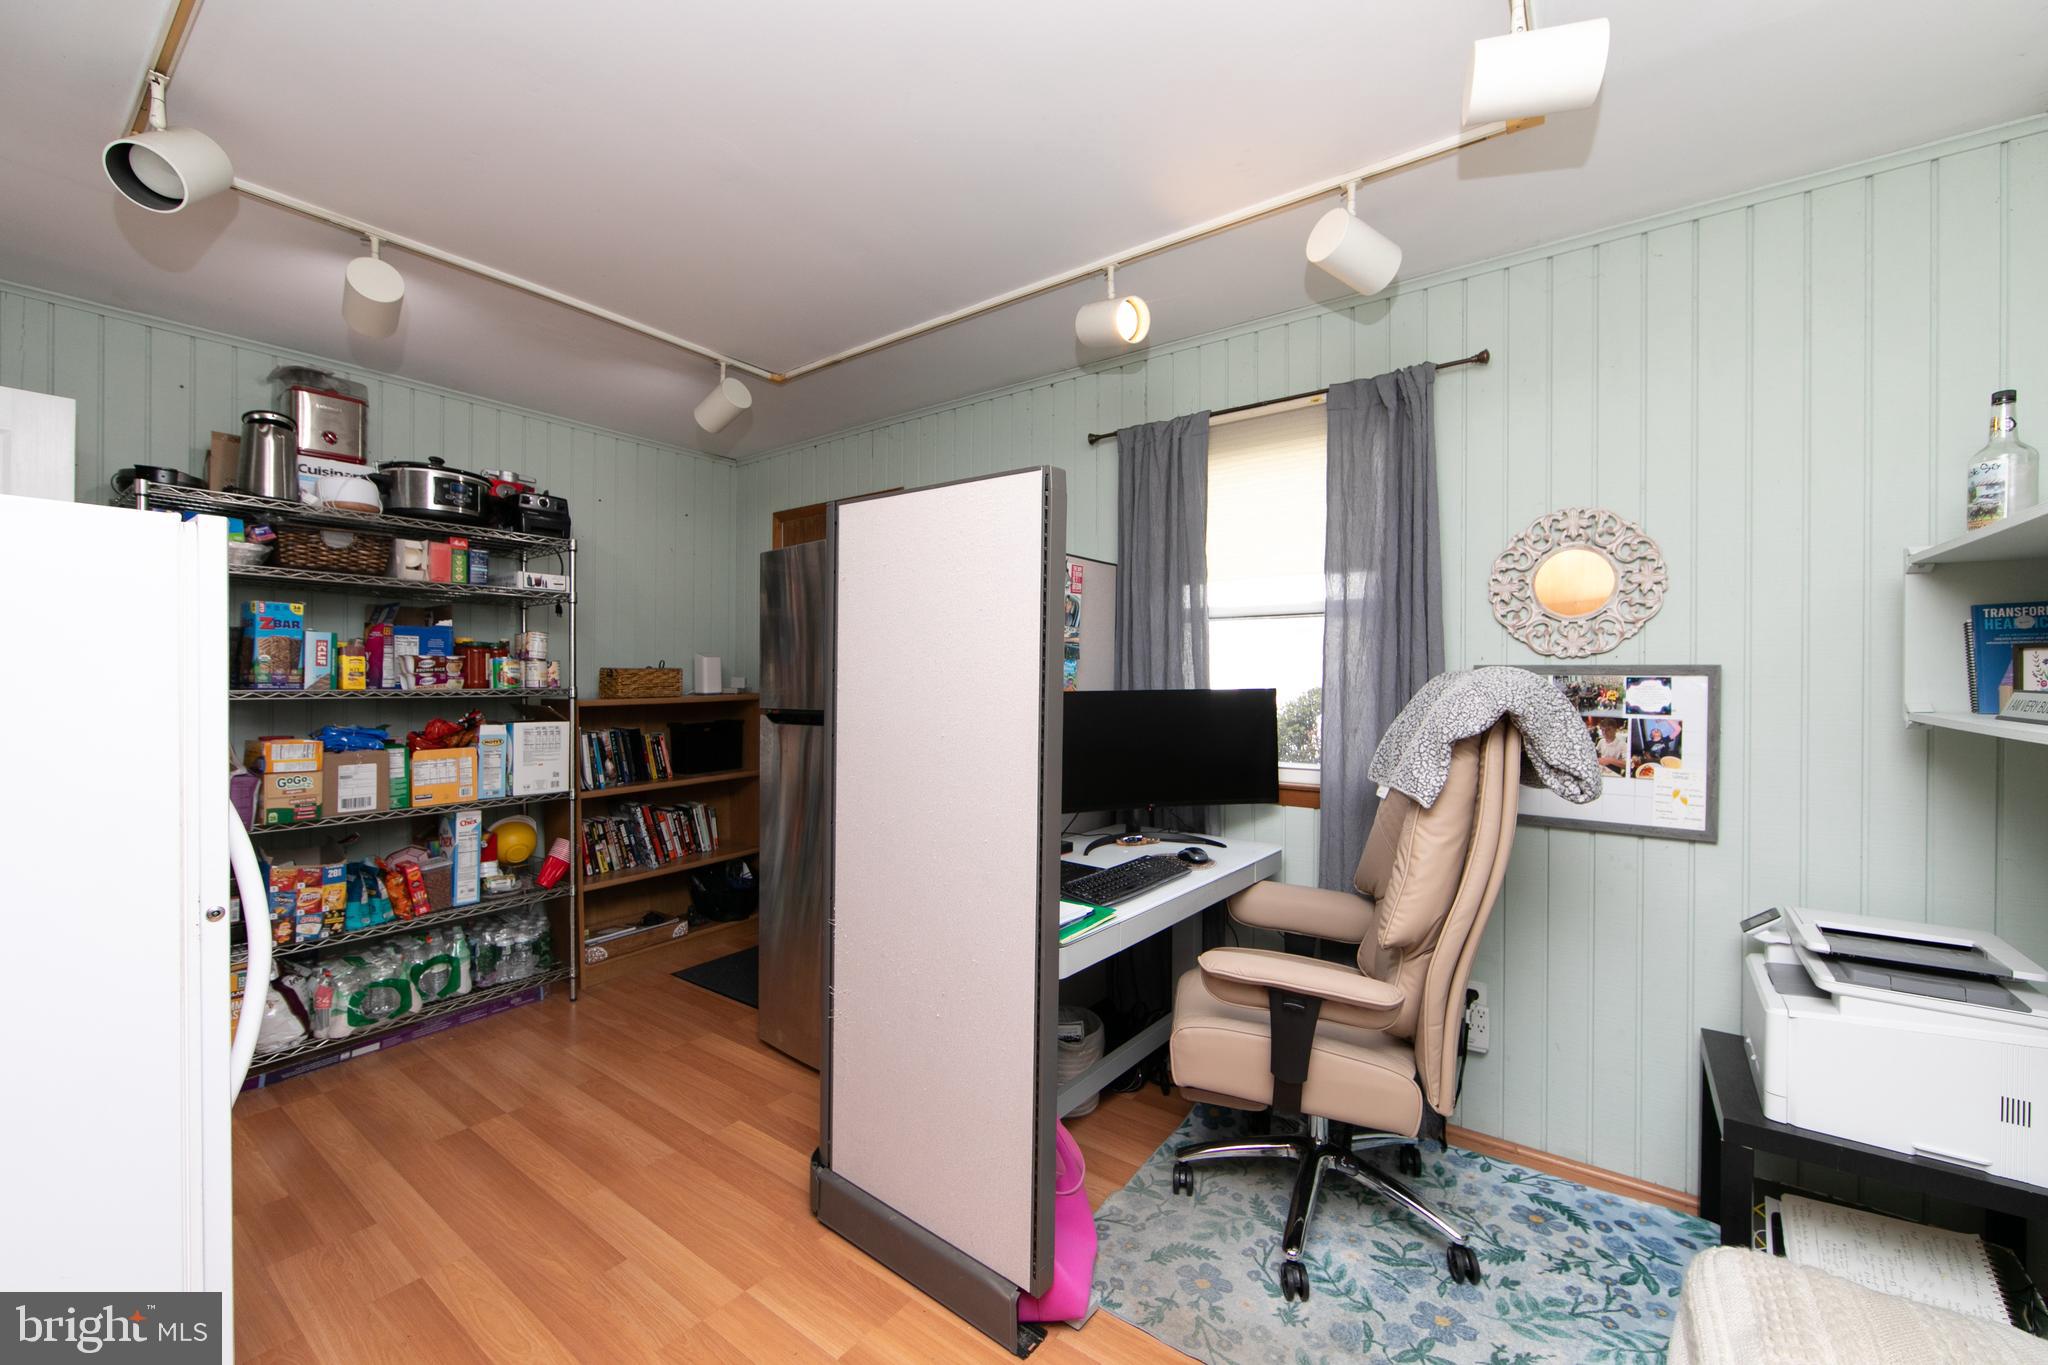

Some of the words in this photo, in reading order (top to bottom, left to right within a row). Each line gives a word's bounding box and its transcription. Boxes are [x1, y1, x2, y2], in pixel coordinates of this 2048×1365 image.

[1983, 605, 2048, 618] TRANSFOR
[317, 645, 328, 667] CLIF
[460, 818, 477, 827] Chex
